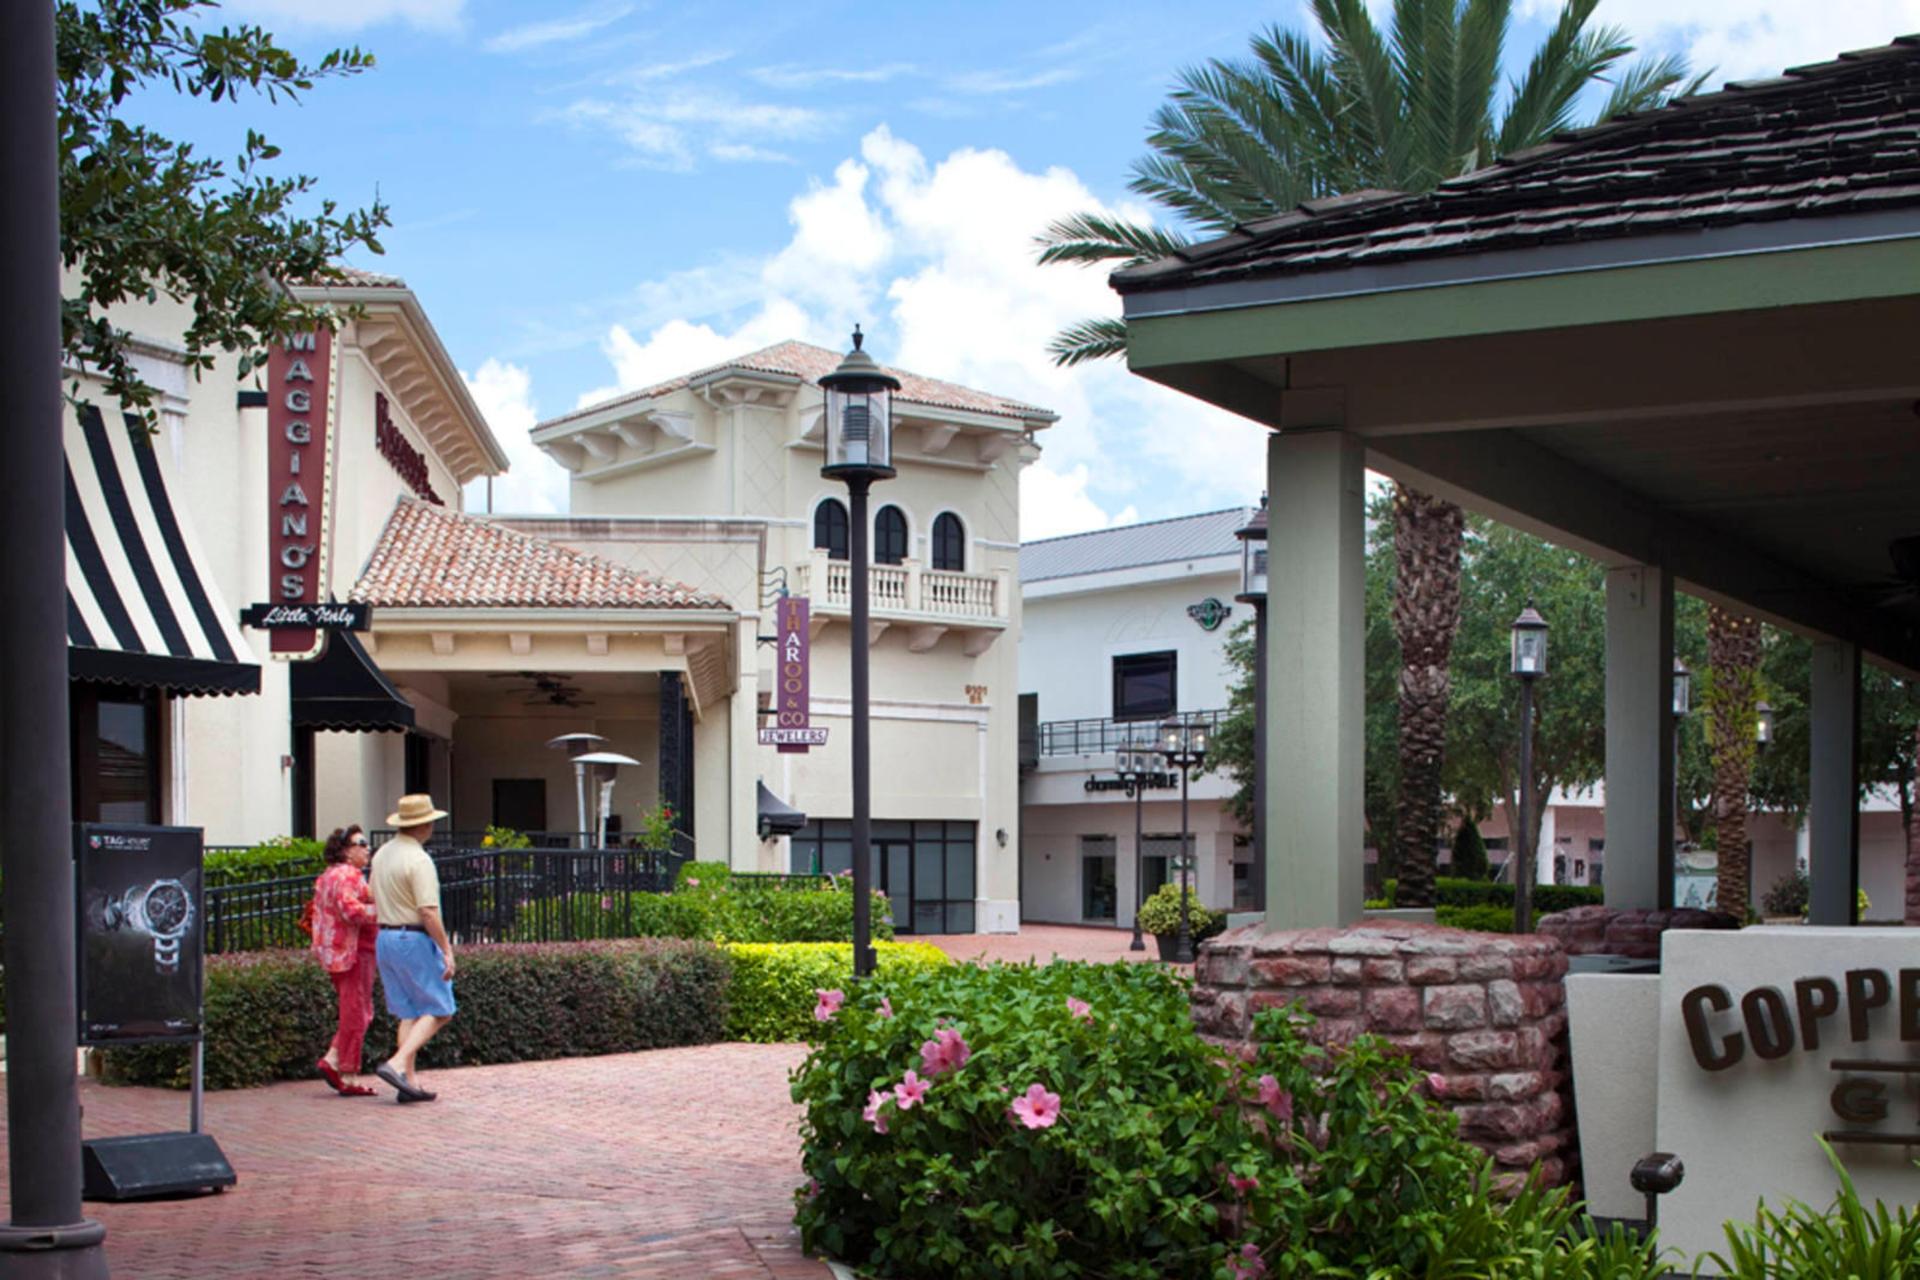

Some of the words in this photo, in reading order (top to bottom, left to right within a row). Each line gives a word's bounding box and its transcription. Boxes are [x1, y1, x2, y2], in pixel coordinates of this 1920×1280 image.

[262, 606, 311, 626] Little
[309, 606, 356, 628] Italy
[784, 601, 803, 693] THAROO
[786, 698, 798, 709] &
[760, 730, 825, 742] JEWELERS
